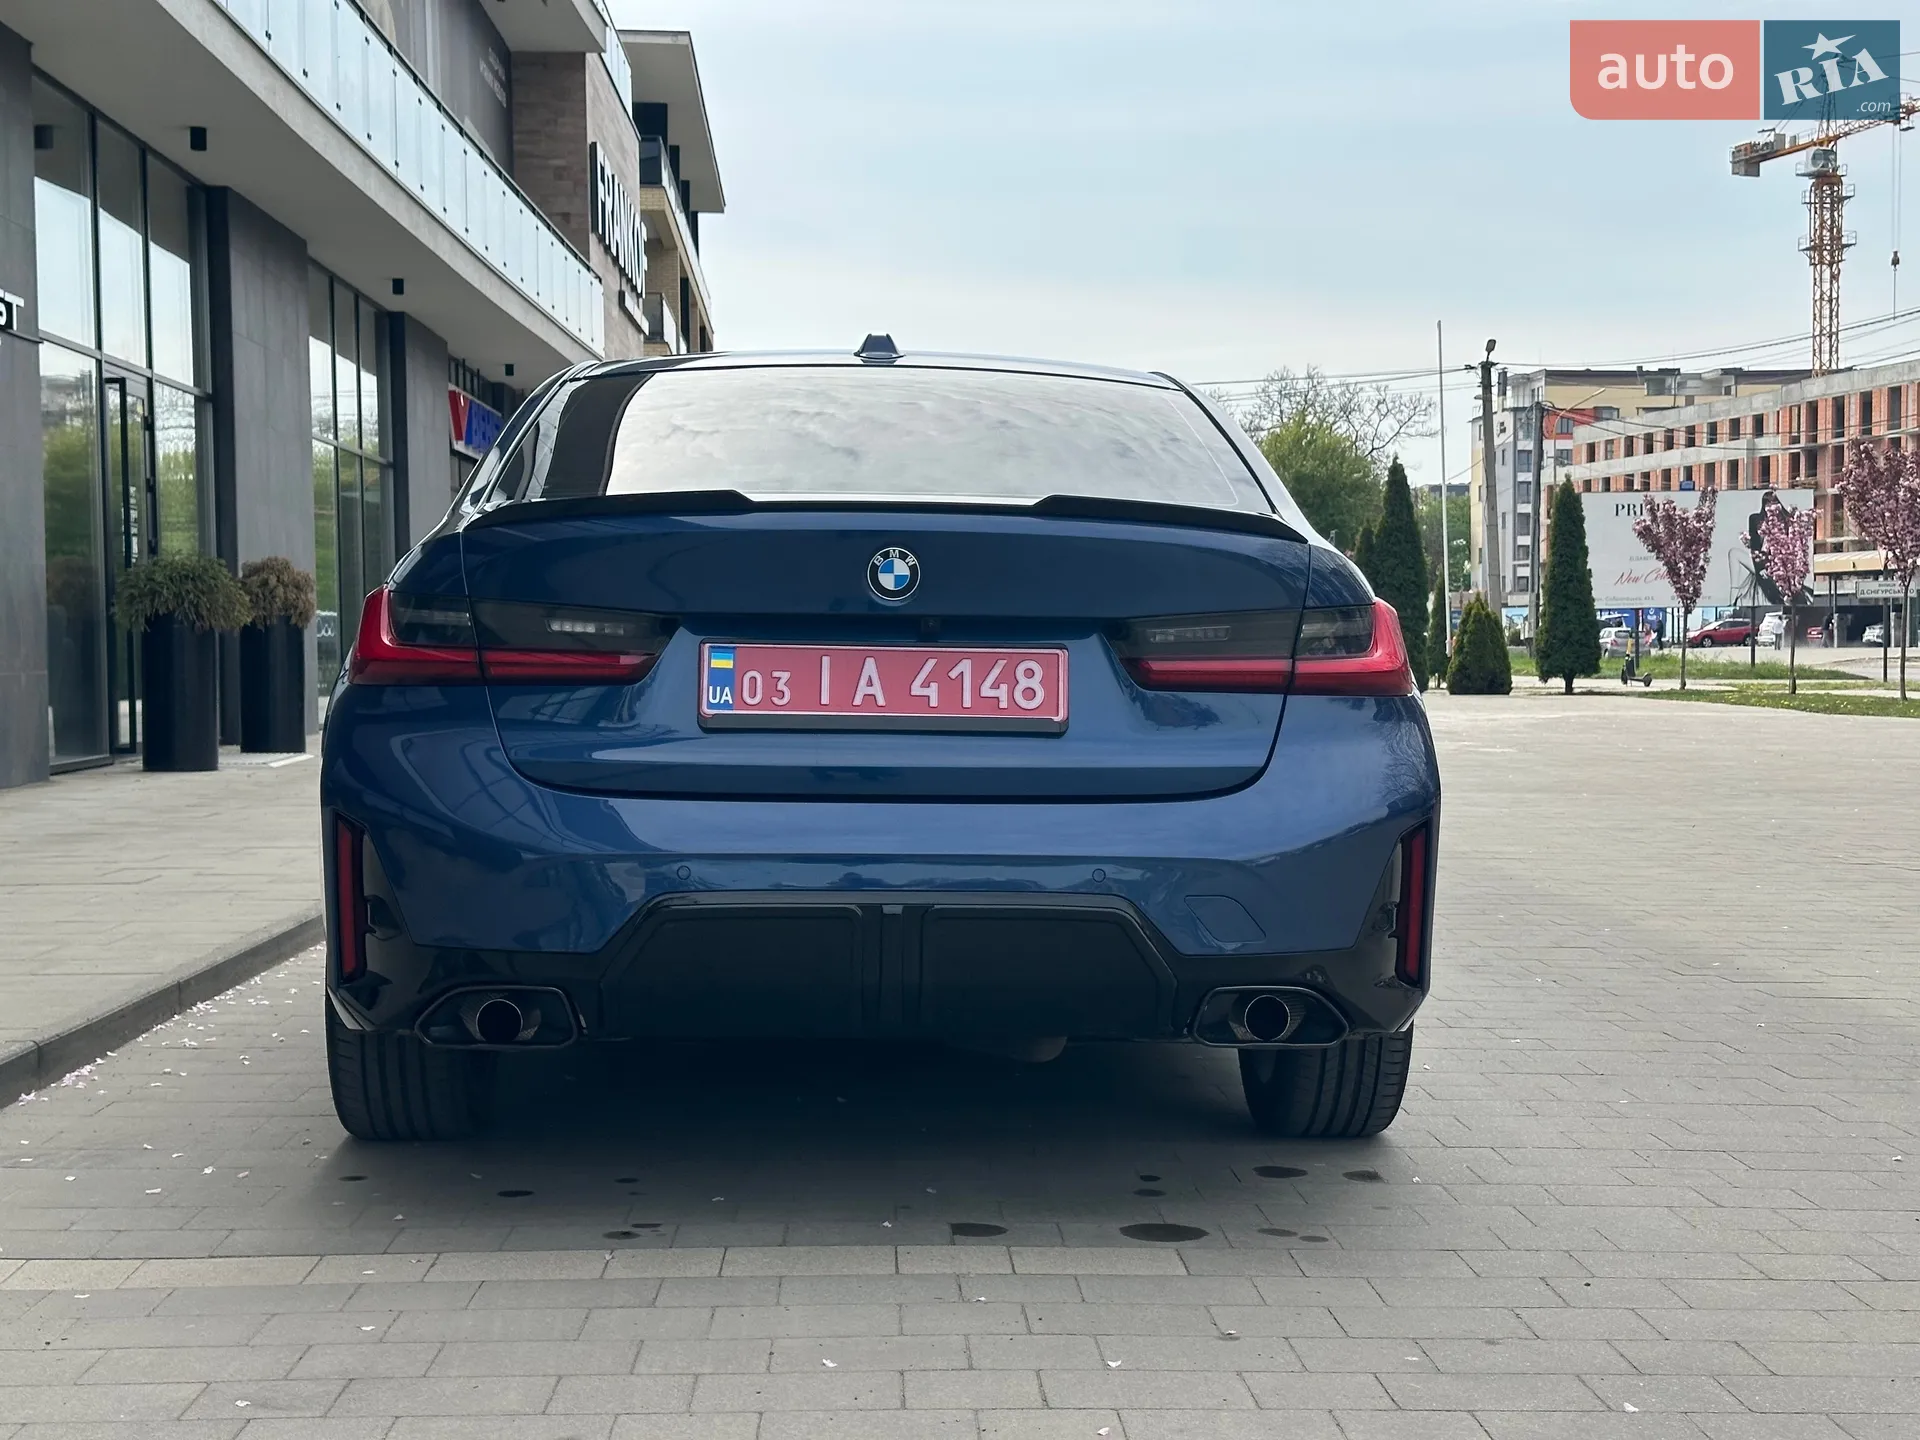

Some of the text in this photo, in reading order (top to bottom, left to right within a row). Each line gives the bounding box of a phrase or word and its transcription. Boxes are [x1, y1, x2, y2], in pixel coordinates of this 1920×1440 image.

[873, 549, 917, 567] BMW
[708, 686, 733, 705] UA
[740, 669, 792, 707] 03
[909, 657, 1047, 711] 4148
